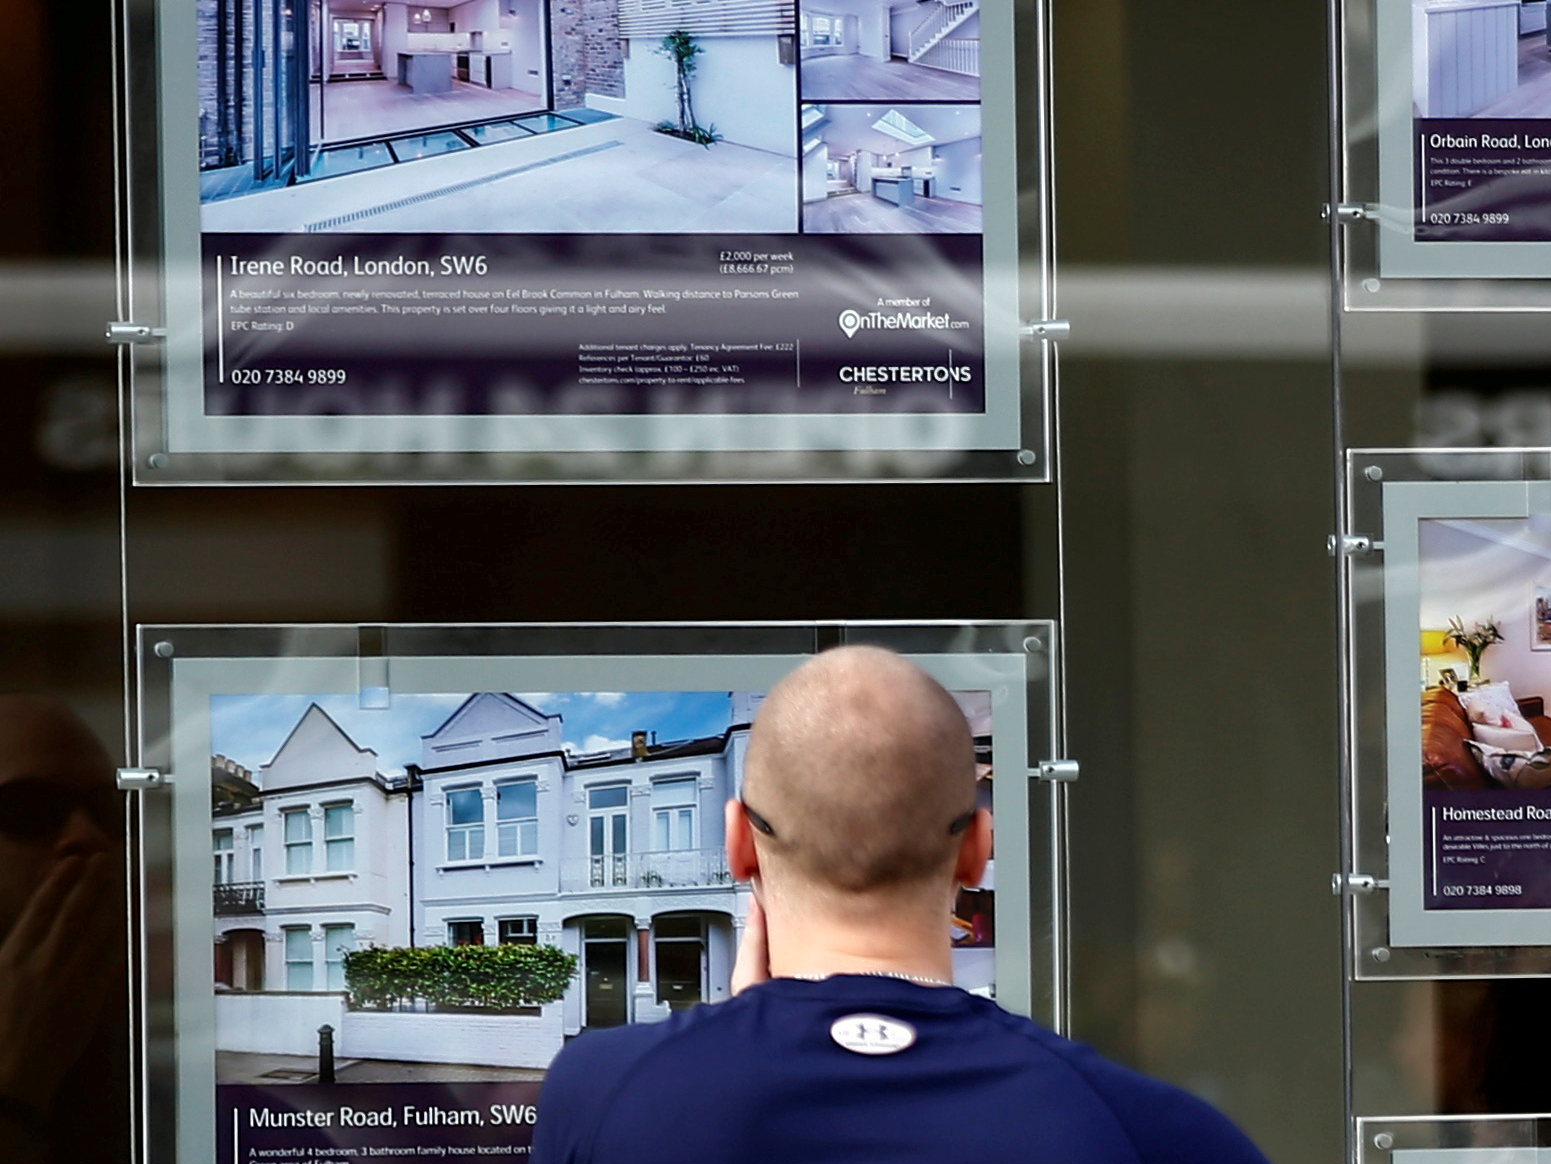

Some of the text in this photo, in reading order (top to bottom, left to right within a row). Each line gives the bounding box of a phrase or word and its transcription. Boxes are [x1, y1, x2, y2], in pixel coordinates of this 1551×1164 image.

[1430, 134, 1477, 148] Orbain
[1481, 134, 1521, 148] Road,
[1430, 212, 1509, 224] 020 7384 9899
[230, 255, 487, 276] Irene Road, London, SW6
[876, 297, 930, 307] A member of
[231, 369, 346, 384] 020 7384 9899
[839, 366, 972, 383] CHESTERTONS
[1442, 807, 1523, 820] Homestead
[249, 1104, 537, 1127] Munster Road, Fulham, SW6
